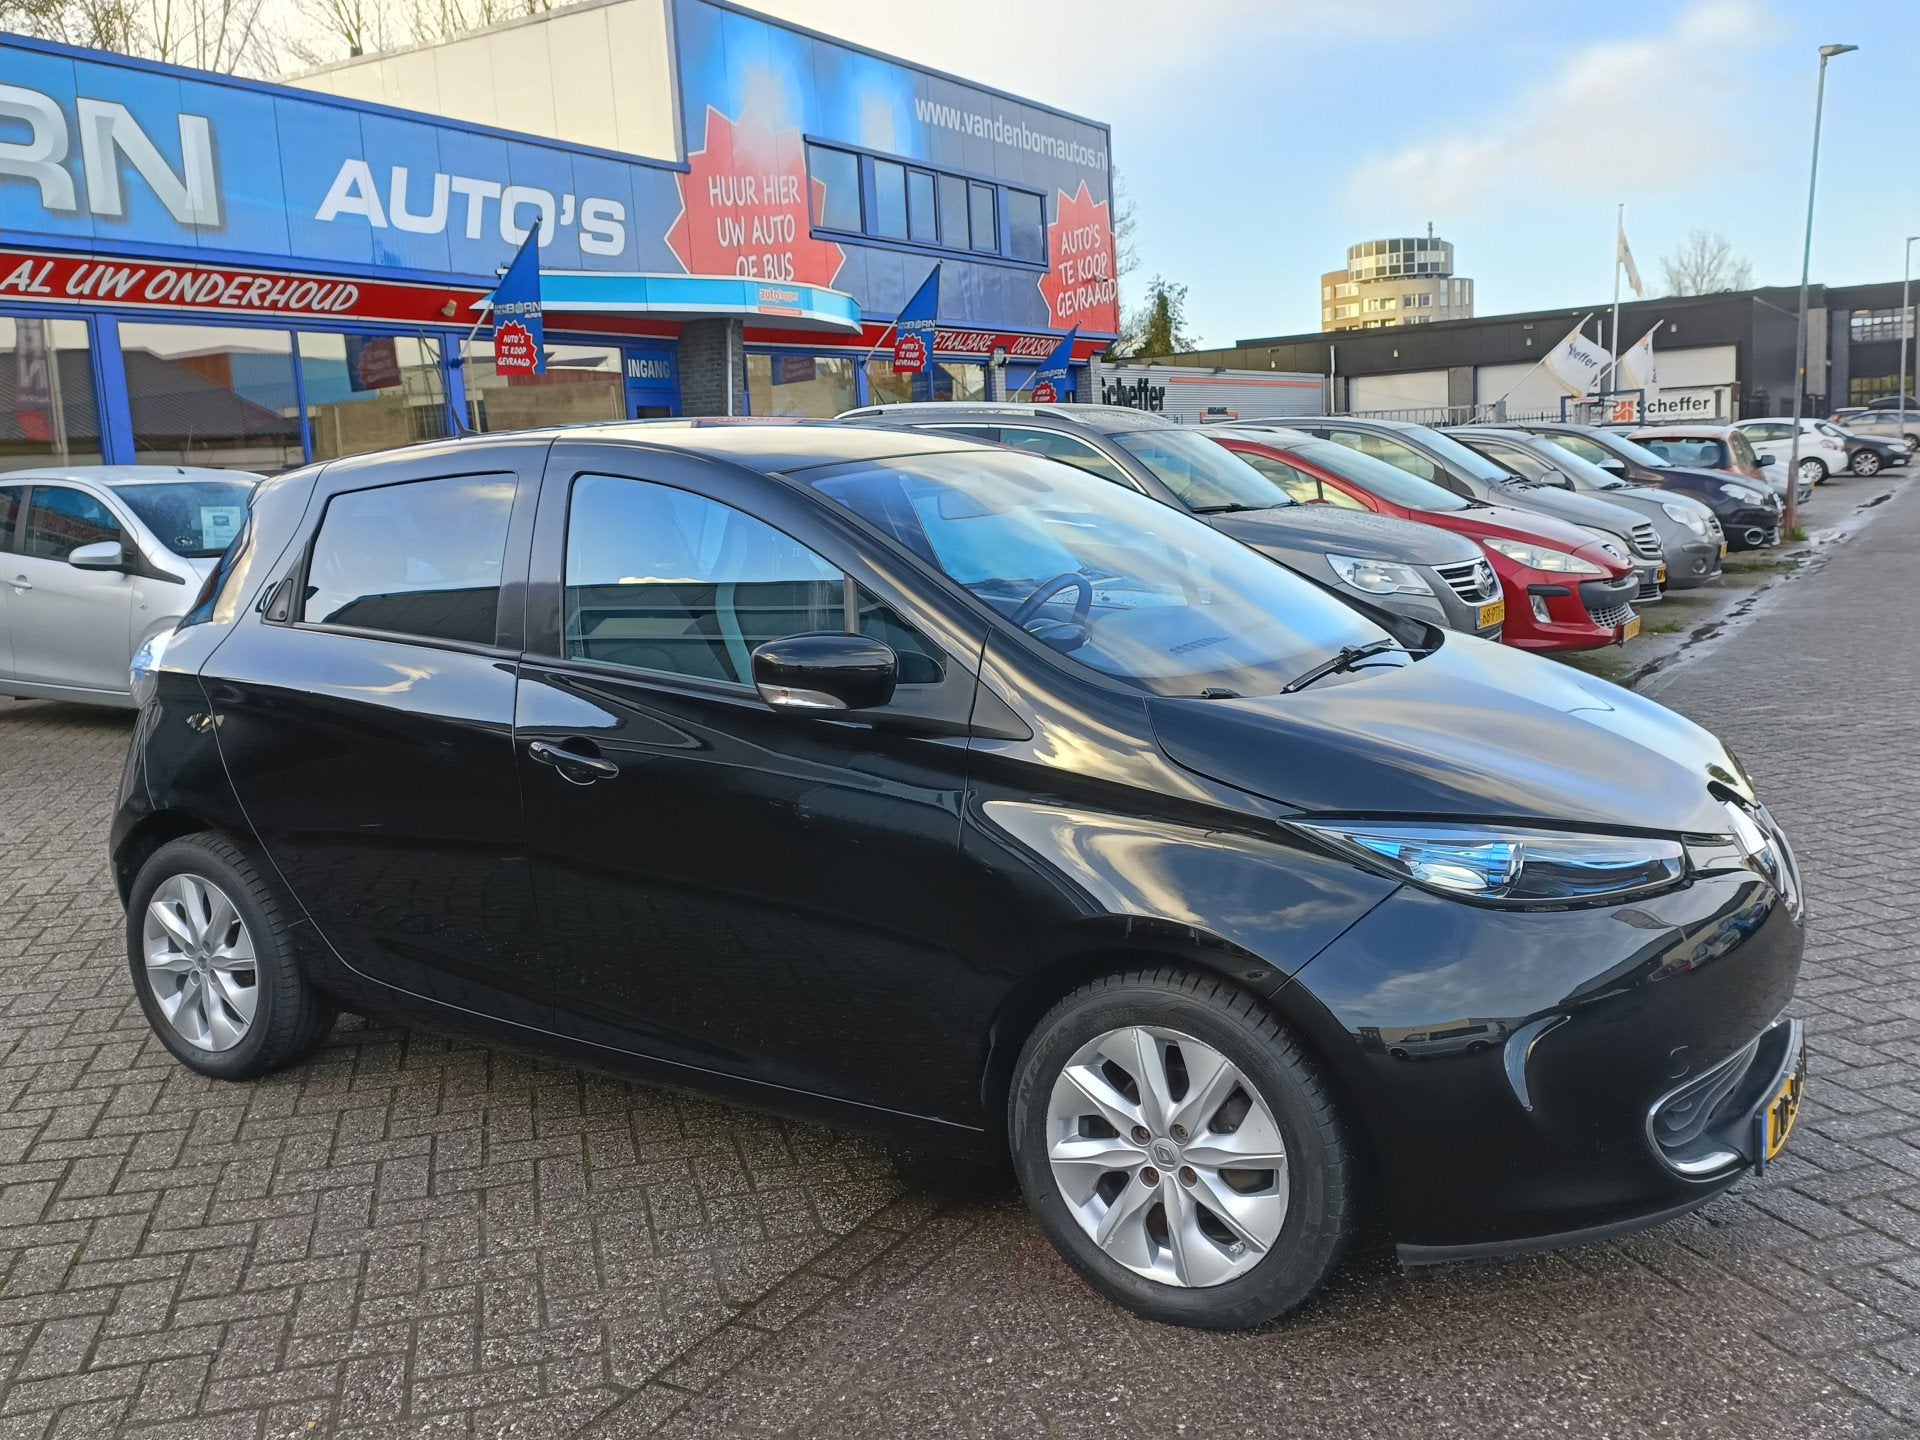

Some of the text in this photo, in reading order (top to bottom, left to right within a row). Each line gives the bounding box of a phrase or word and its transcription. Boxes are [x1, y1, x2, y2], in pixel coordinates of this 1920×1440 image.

[914, 97, 1109, 172] www.vandenbornautos.nl
[314, 158, 626, 256] AUTO'S
[708, 175, 801, 207] HUUR HIER
[716, 213, 796, 248] UW AUTO
[1061, 223, 1101, 257] AUTO'S
[736, 252, 795, 282] OF BUS
[1058, 252, 1108, 286] TE KOOP
[0, 259, 359, 312] AL UW ONDERHOUD
[1056, 277, 1117, 319] GEVRAAGD
[502, 346, 527, 355] TE KOOP
[503, 333, 525, 344] AUTO'S
[498, 357, 531, 368] GEVRAAGD
[628, 358, 671, 379] INGANG
